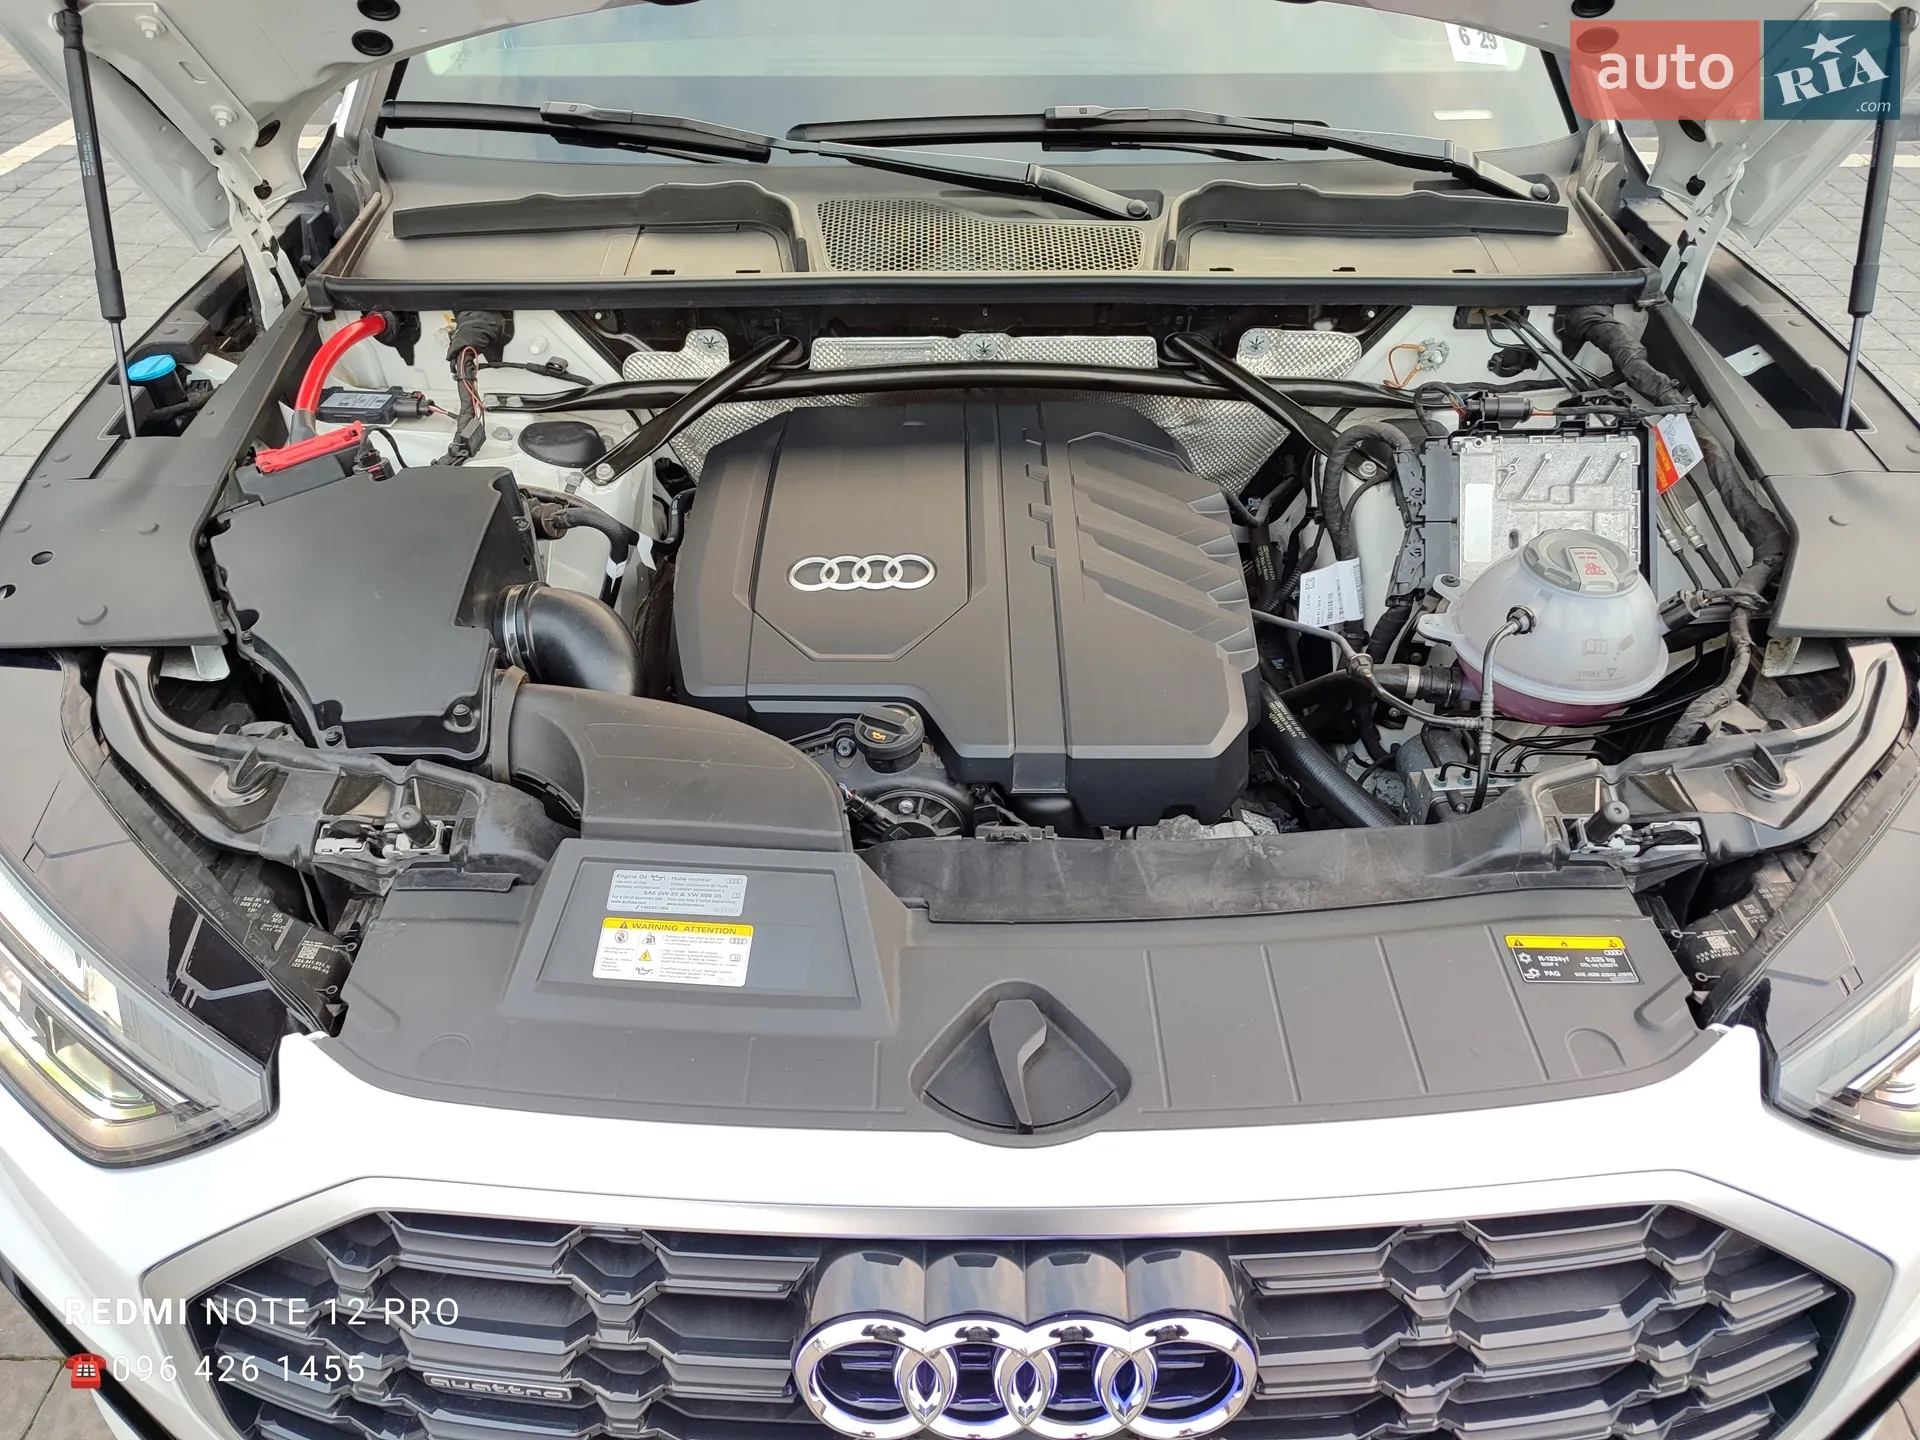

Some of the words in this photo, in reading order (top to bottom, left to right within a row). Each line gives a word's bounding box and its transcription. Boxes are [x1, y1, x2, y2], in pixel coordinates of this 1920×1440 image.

[1458, 26, 1471, 46] 6
[1477, 29, 1497, 50] 29
[1577, 668, 1601, 678] max
[632, 923, 678, 932] WARNING
[684, 926, 737, 935] ATTENTION
[1538, 955, 1570, 963] R-1234yf
[429, 1378, 563, 1400] quattro
